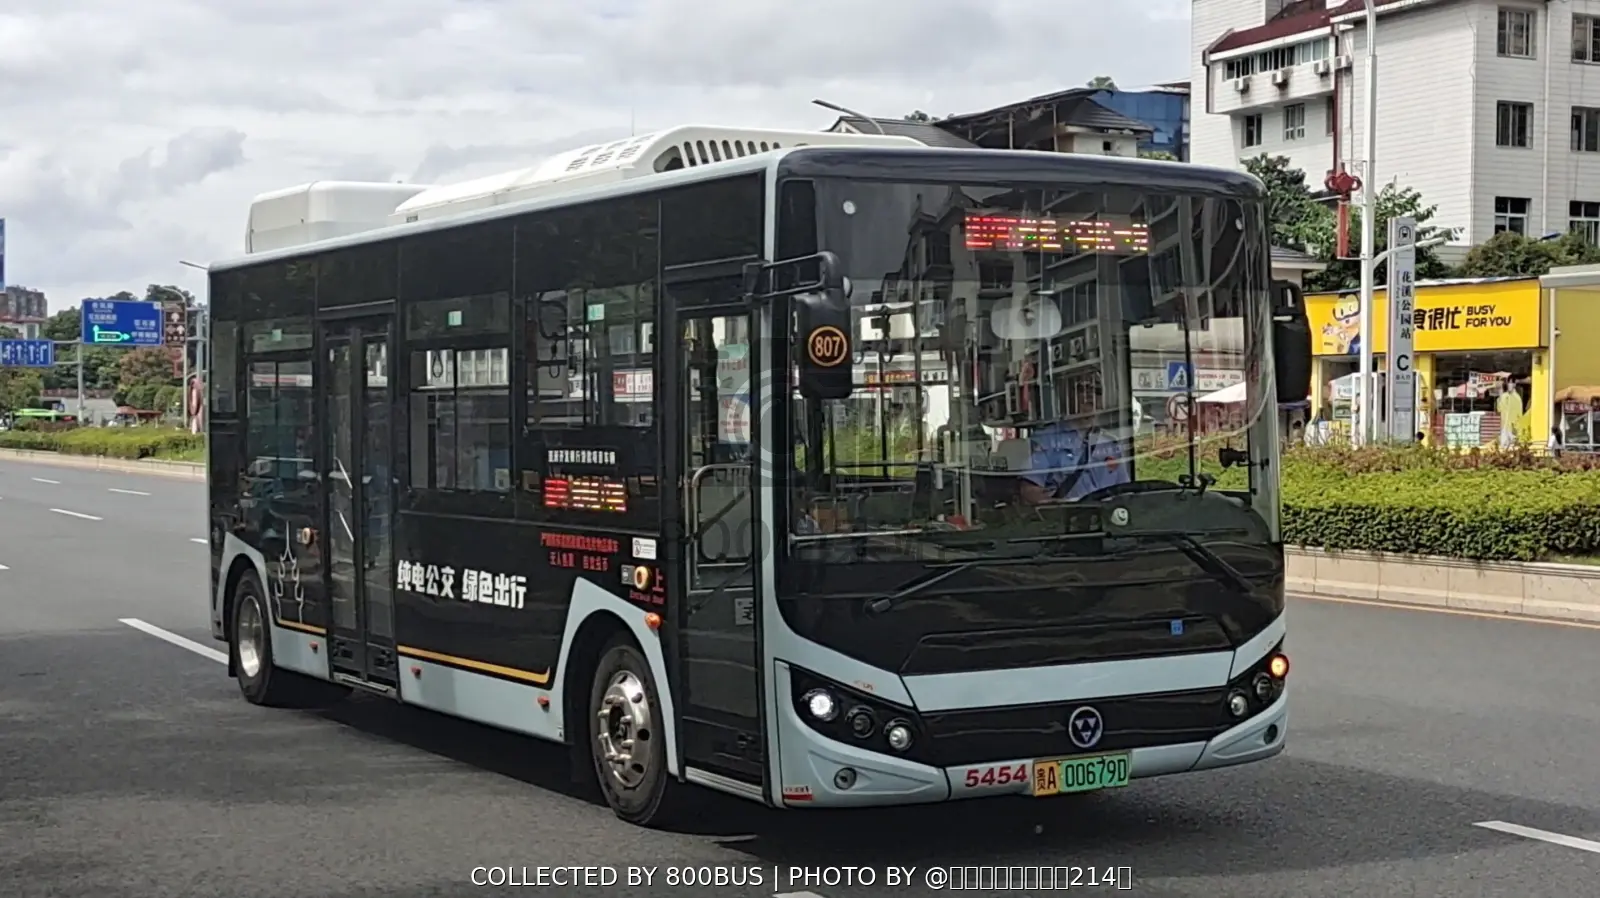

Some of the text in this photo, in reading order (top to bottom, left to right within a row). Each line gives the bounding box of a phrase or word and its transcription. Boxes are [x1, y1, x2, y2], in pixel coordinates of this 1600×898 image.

[1401, 271, 1412, 339] 花溪公园站
[1466, 305, 1496, 316] BUSY
[1465, 316, 1512, 328] FOR YOU
[815, 335, 841, 357] 807
[1397, 354, 1409, 371] C
[397, 559, 527, 609] 纯电公交 绿色出行
[652, 568, 664, 592] 上
[965, 764, 1027, 788] 5454
[1065, 758, 1127, 788] 00679D
